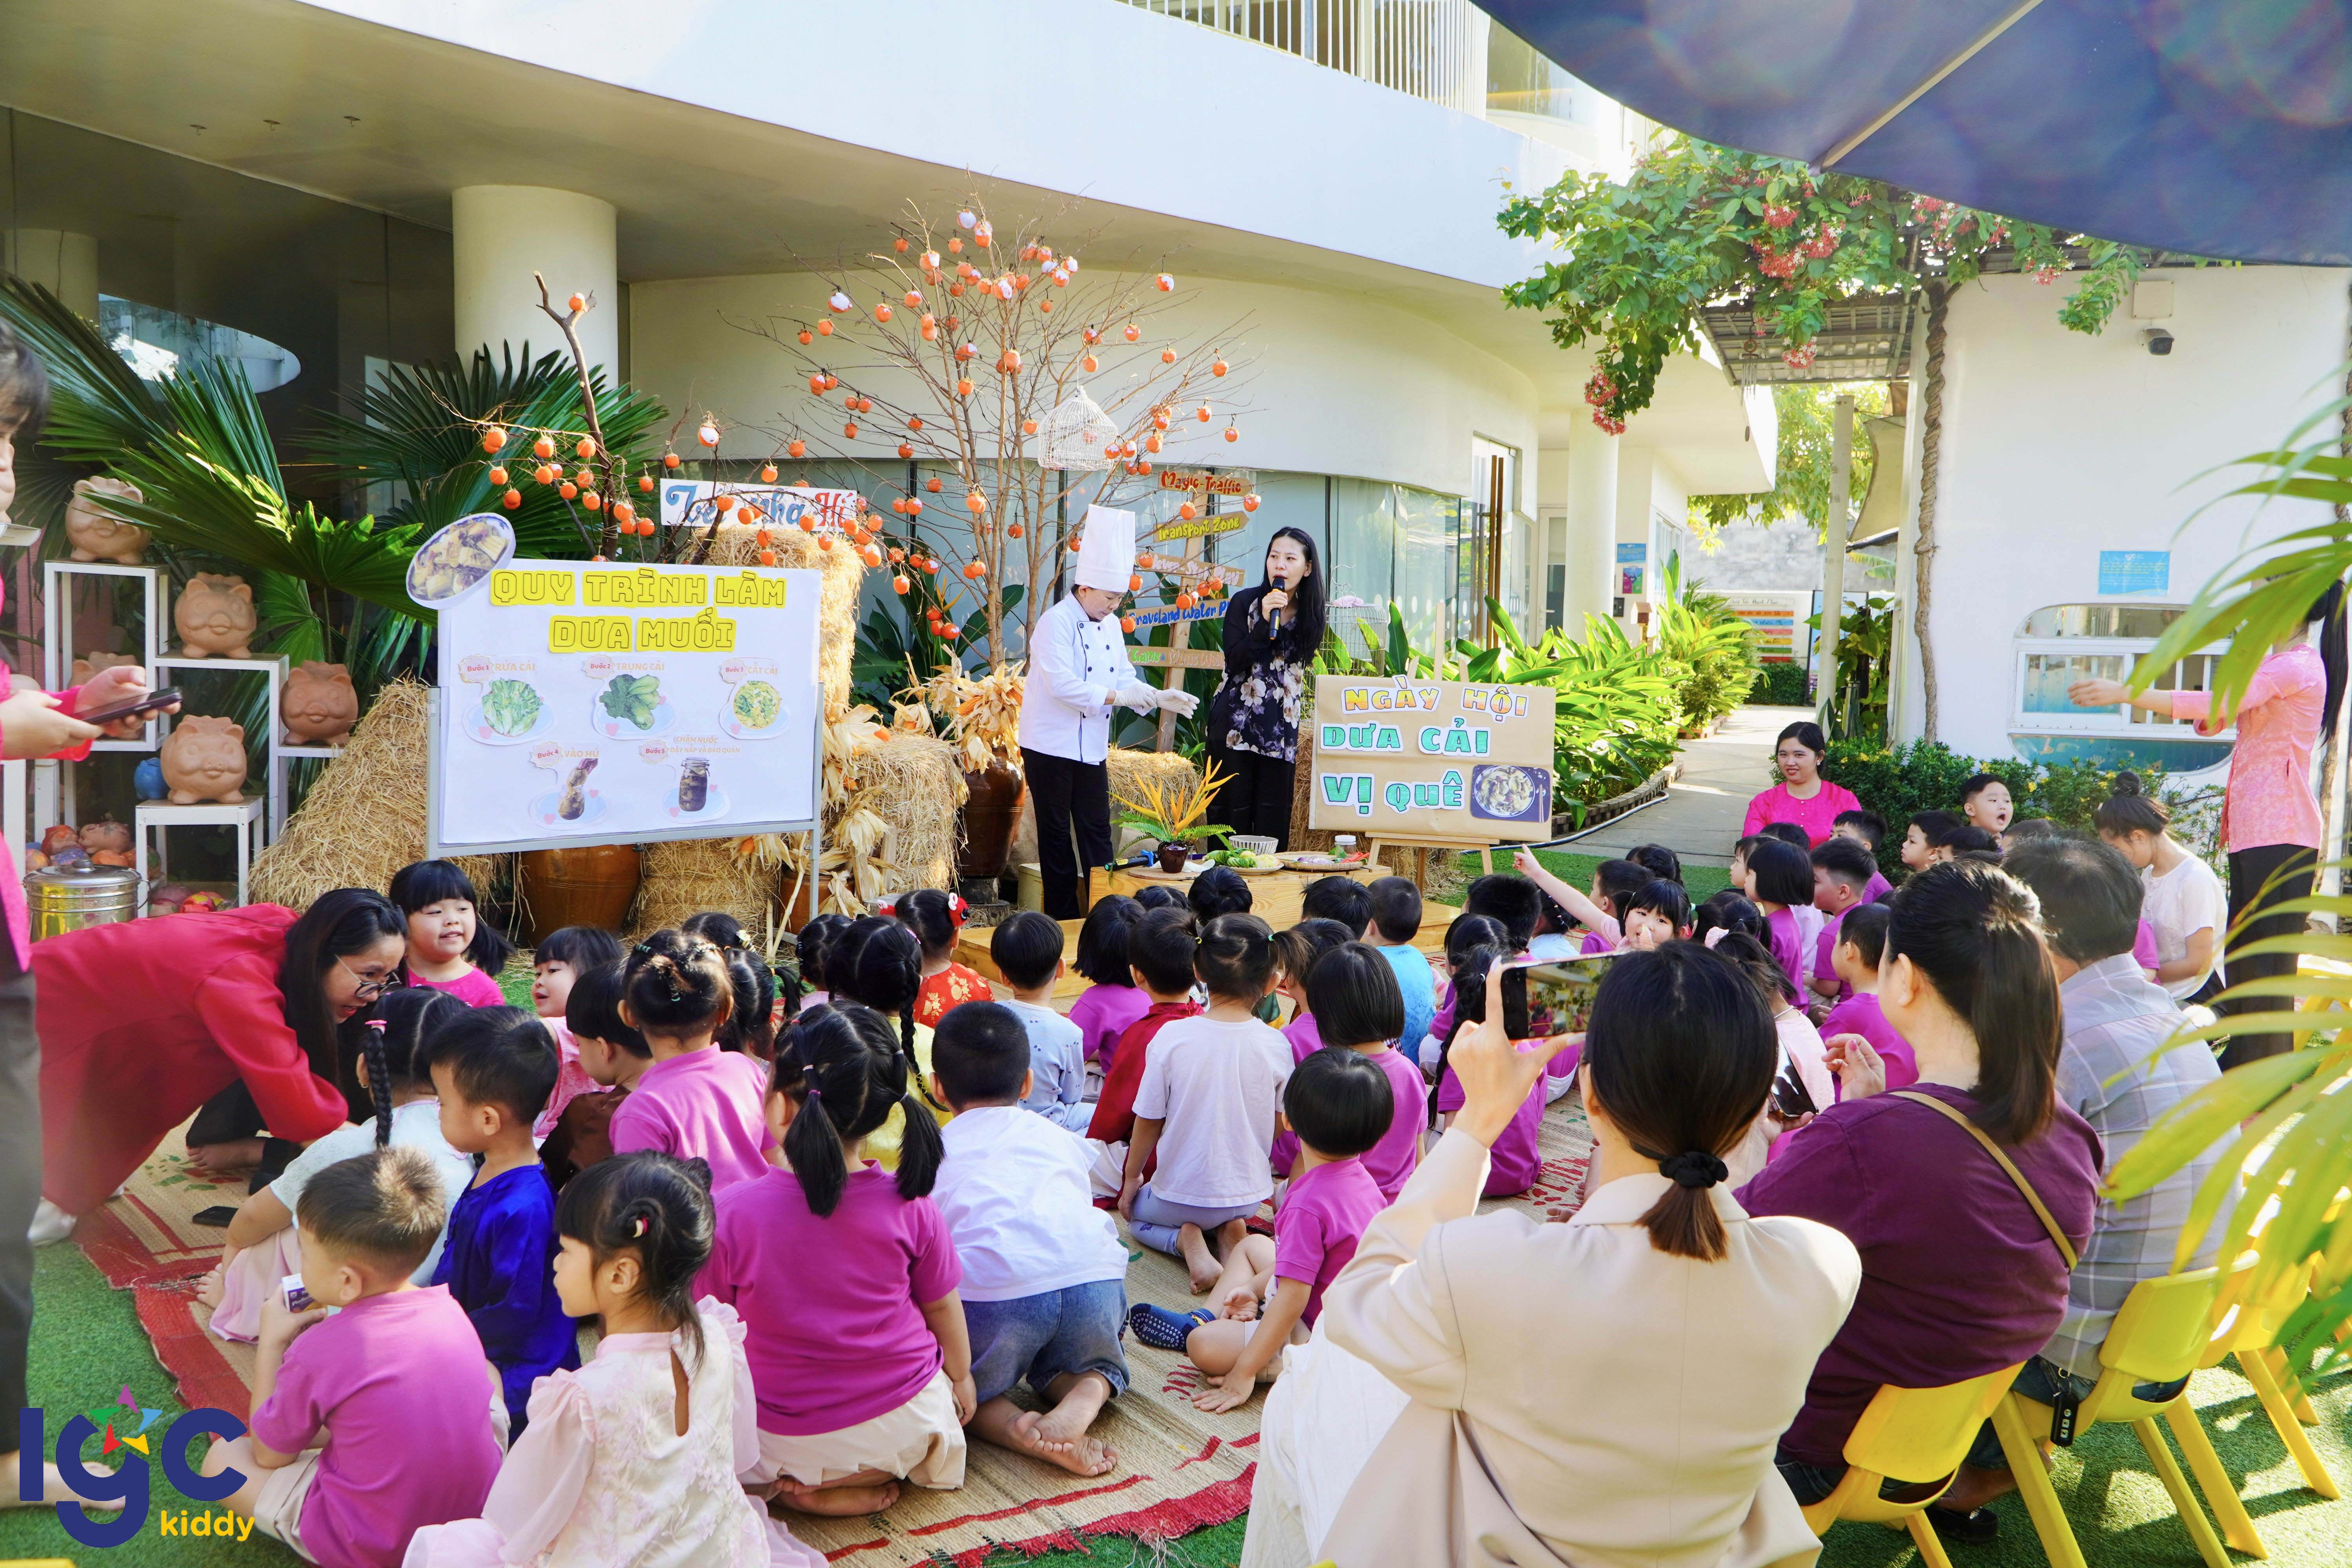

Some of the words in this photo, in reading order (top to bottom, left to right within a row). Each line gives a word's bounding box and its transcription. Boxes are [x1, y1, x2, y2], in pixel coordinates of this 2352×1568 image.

[1161, 471, 1241, 495] Magic-Traffic
[1157, 518, 1210, 541] Transport
[1213, 516, 1240, 532] Zone
[1214, 566, 1240, 586] Play
[494, 571, 575, 603] QUY
[586, 568, 706, 604] TRÌNH
[715, 570, 784, 606] LÀM
[1183, 602, 1217, 622] Water
[554, 619, 629, 649] DƯA
[641, 607, 732, 648] MUỐI
[495, 660, 517, 671] RỬA
[519, 660, 535, 671] CẢI
[1131, 648, 1161, 664] Game
[1168, 649, 1198, 666] Music
[616, 663, 648, 673] TRỤNG
[650, 660, 665, 671] CẢI
[747, 662, 763, 674] CẮT
[764, 665, 778, 675] CẢI
[1344, 675, 1440, 711] NGÀY
[1463, 686, 1528, 722] HỘI
[676, 734, 696, 743] CHÂM
[697, 735, 718, 744] NƯỚC
[1323, 723, 1401, 748] DƯA
[1421, 717, 1489, 754] CẢI
[537, 750, 554, 758] Bước
[564, 747, 583, 758] VÀO
[585, 747, 599, 758] HỦ
[670, 746, 683, 754] ĐẬY
[684, 744, 697, 753] NẮP
[722, 745, 740, 753] QUẢN
[1323, 777, 1372, 815] VỊ
[1386, 770, 1463, 812] QUÊ
[1140, 1323, 1158, 1335] socks
[1158, 1332, 1175, 1343] baby
